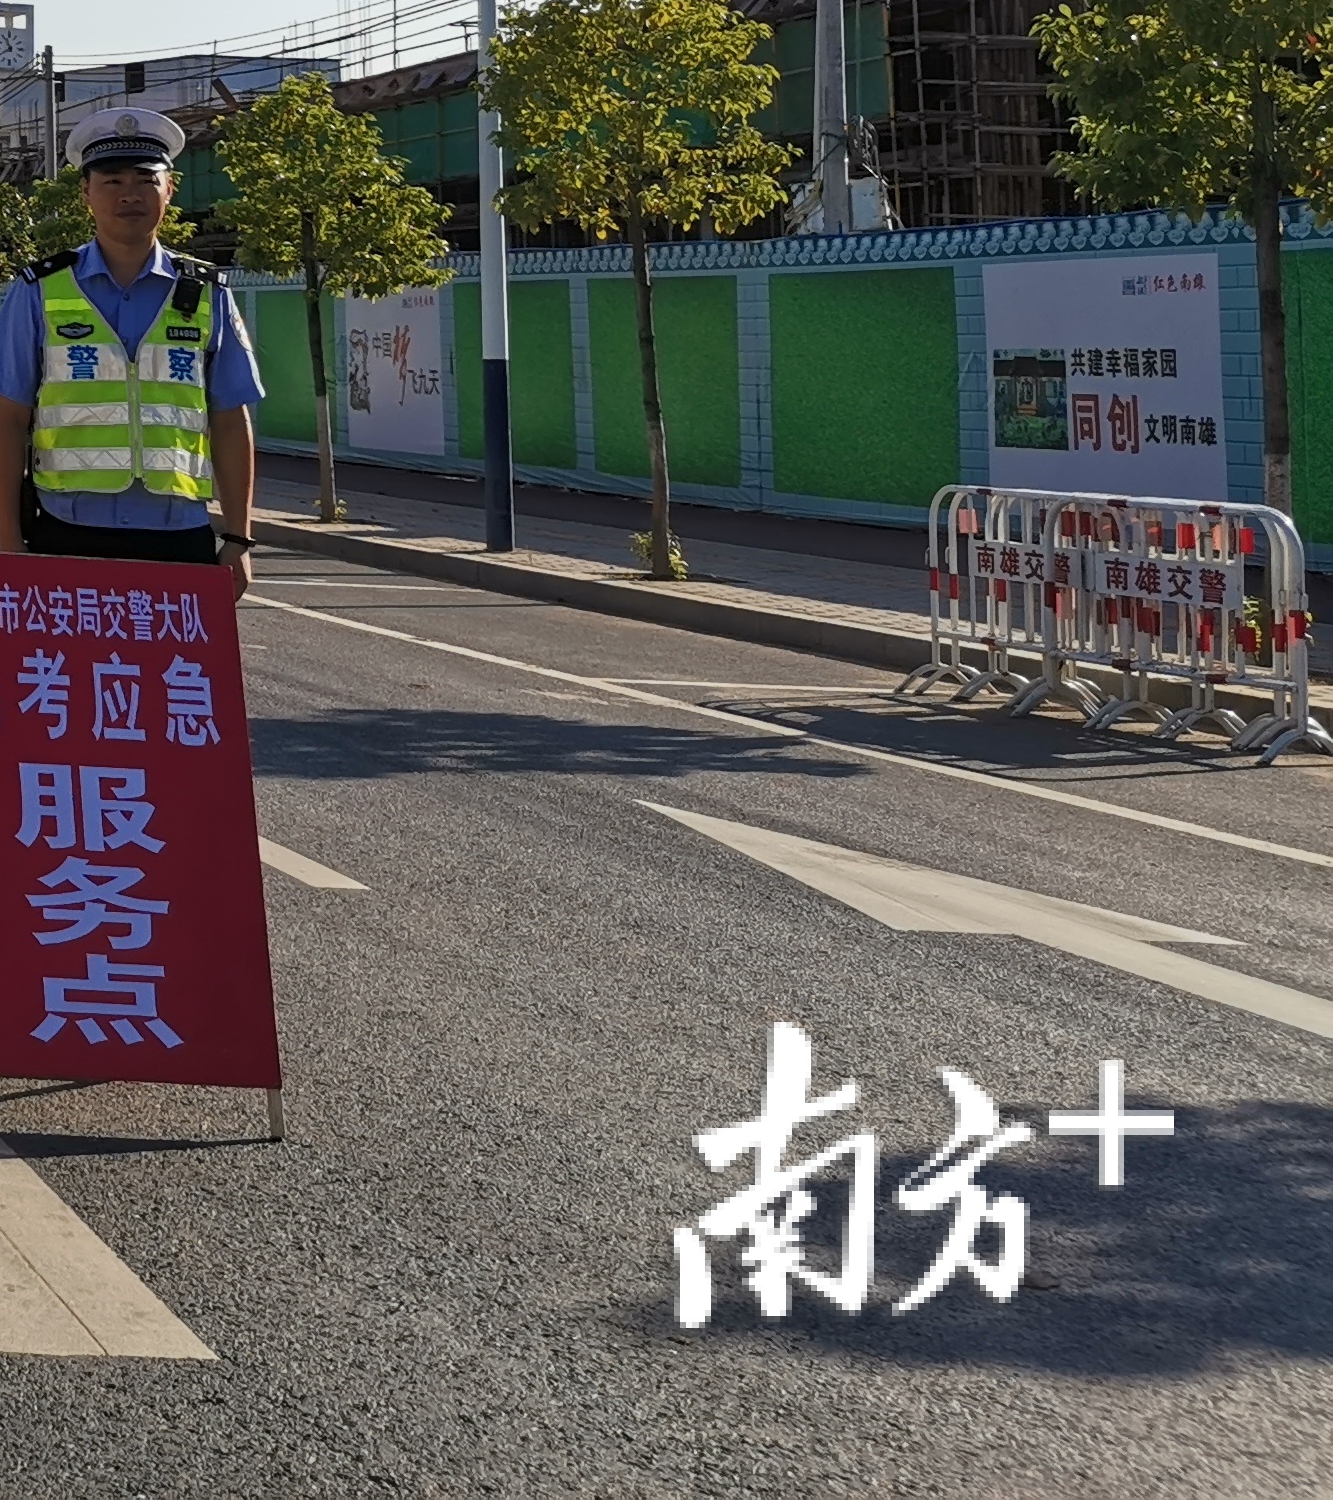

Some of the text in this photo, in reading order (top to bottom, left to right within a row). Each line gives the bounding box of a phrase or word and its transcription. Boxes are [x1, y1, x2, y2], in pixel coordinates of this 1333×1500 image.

[66, 344, 196, 383] 警察
[1070, 347, 1178, 379] 共建幸福家园
[1071, 392, 1218, 455] 同创 文明南雄
[975, 543, 1071, 587] 南雄交警
[1103, 557, 1228, 605] 南雄交警
[14, 762, 186, 1049] 服务点
